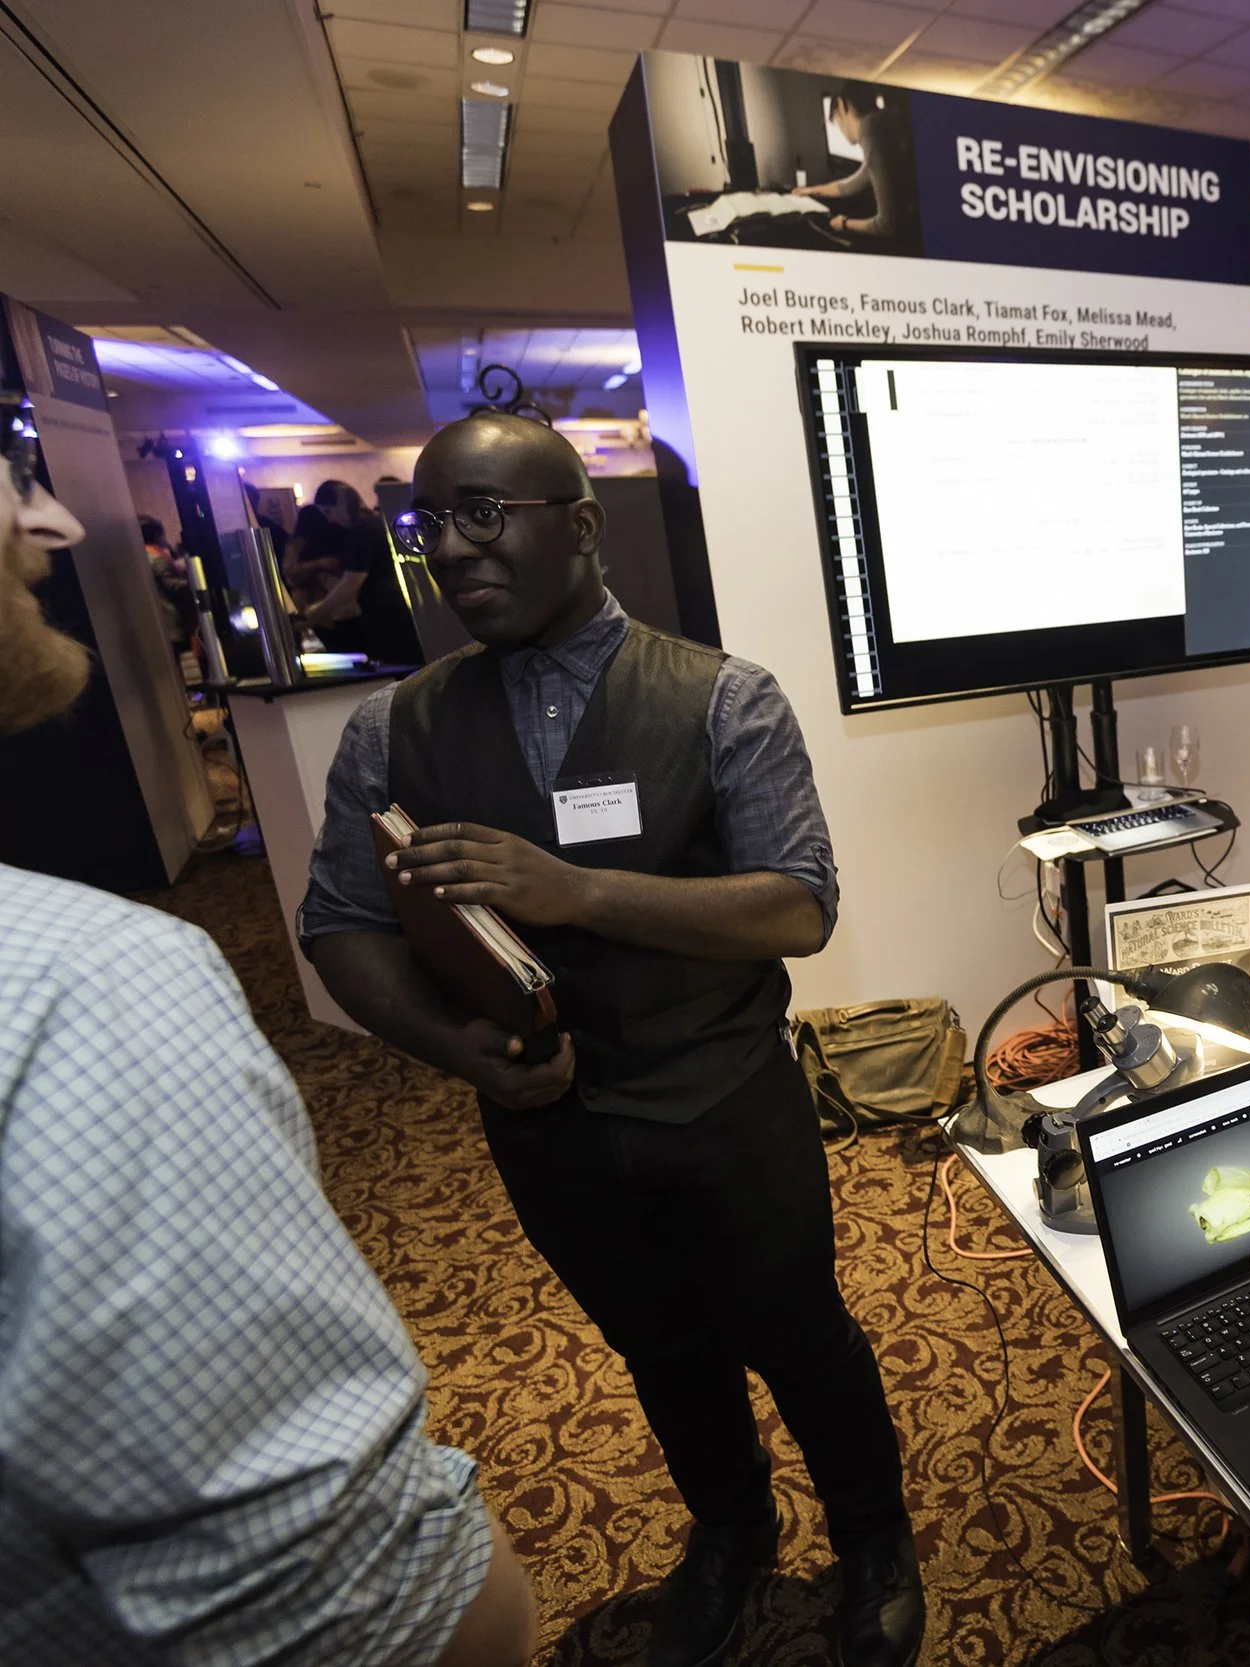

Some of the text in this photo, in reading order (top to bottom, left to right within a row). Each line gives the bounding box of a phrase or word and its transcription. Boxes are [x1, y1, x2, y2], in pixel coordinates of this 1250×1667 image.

[957, 136, 1220, 202] RE-ENVISIONING
[961, 183, 1190, 238] SCHOLARSHIP
[738, 288, 1177, 331] Joel Burges, Famous Clark, Tiamat Fox, Melissa Mead,
[741, 315, 1149, 350] Robert Minckley, Joshua Romphf, Emily Sherwood
[573, 798, 623, 810] Famous Clark
[1161, 920, 1198, 936] SCIENCE
